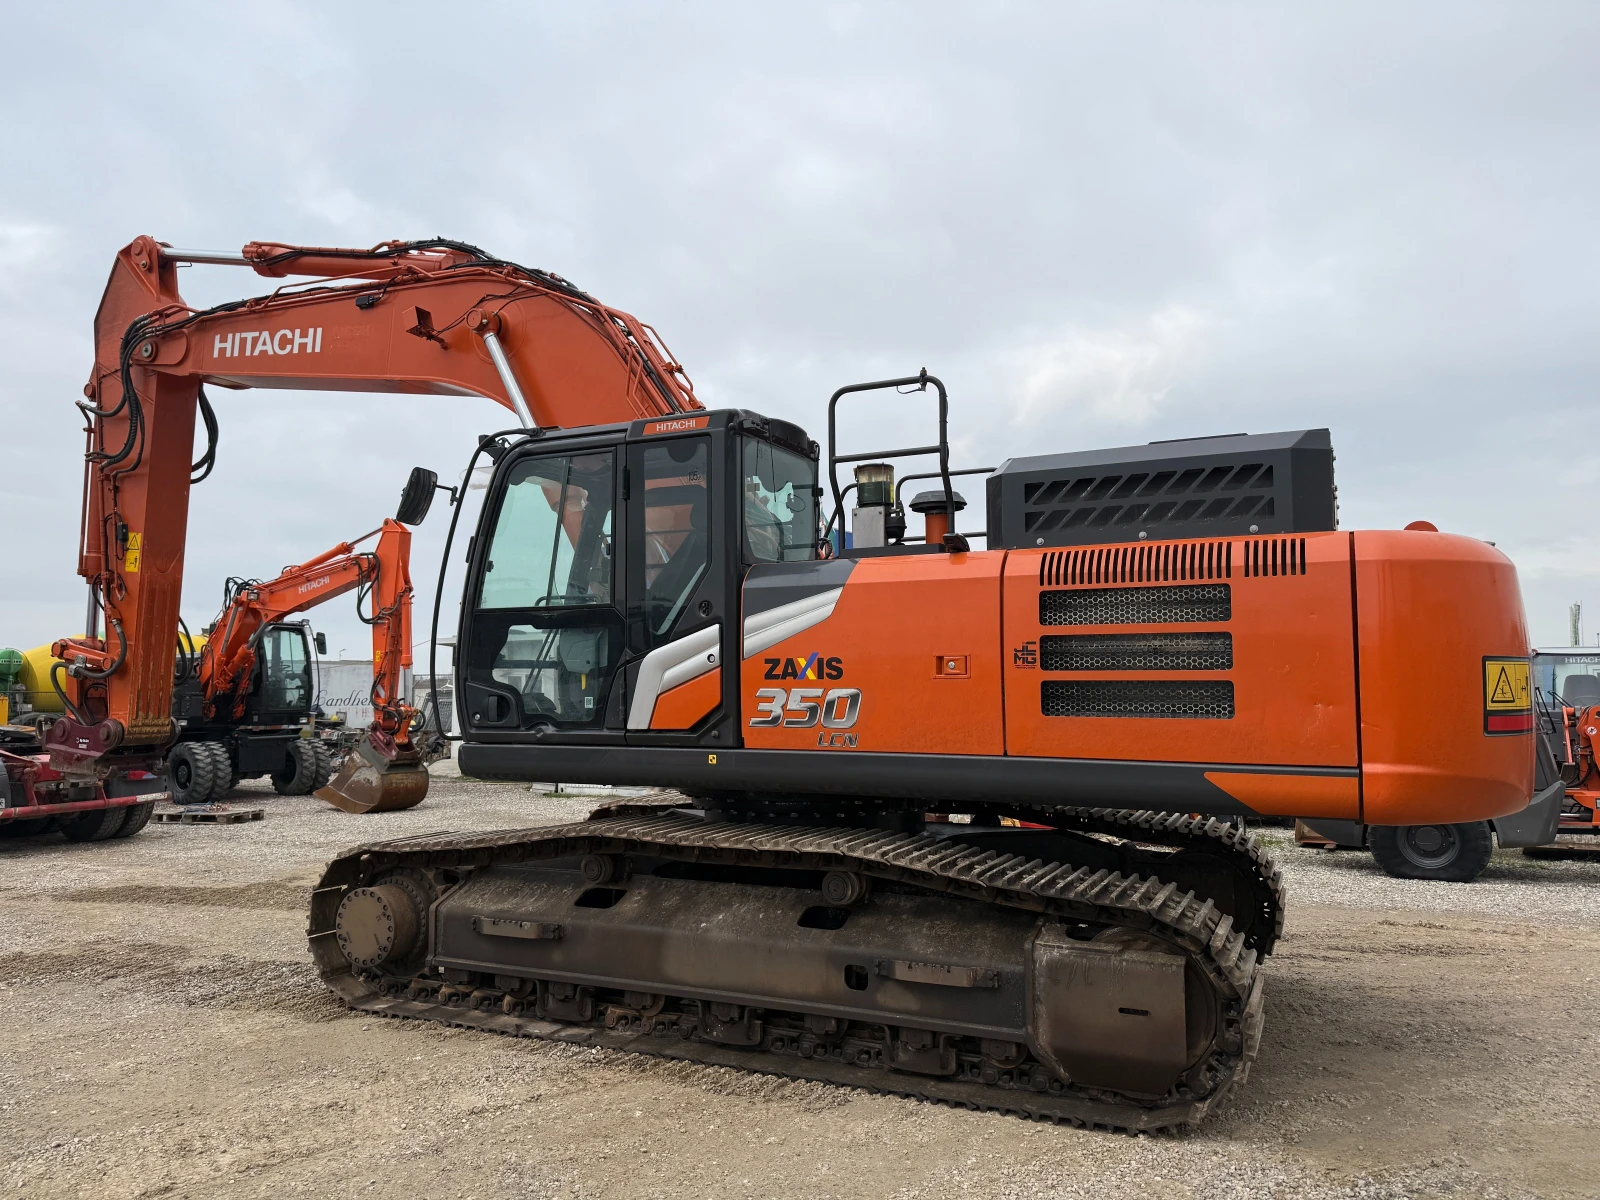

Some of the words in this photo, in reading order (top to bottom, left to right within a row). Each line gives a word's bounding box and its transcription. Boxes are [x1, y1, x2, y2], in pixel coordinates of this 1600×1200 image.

[213, 327, 322, 358] HITACHI
[656, 420, 696, 431] HITACHI
[298, 576, 330, 594] HITACHI
[764, 652, 844, 681] ZAXIS
[749, 687, 862, 729] 350
[817, 732, 859, 747] LCN
